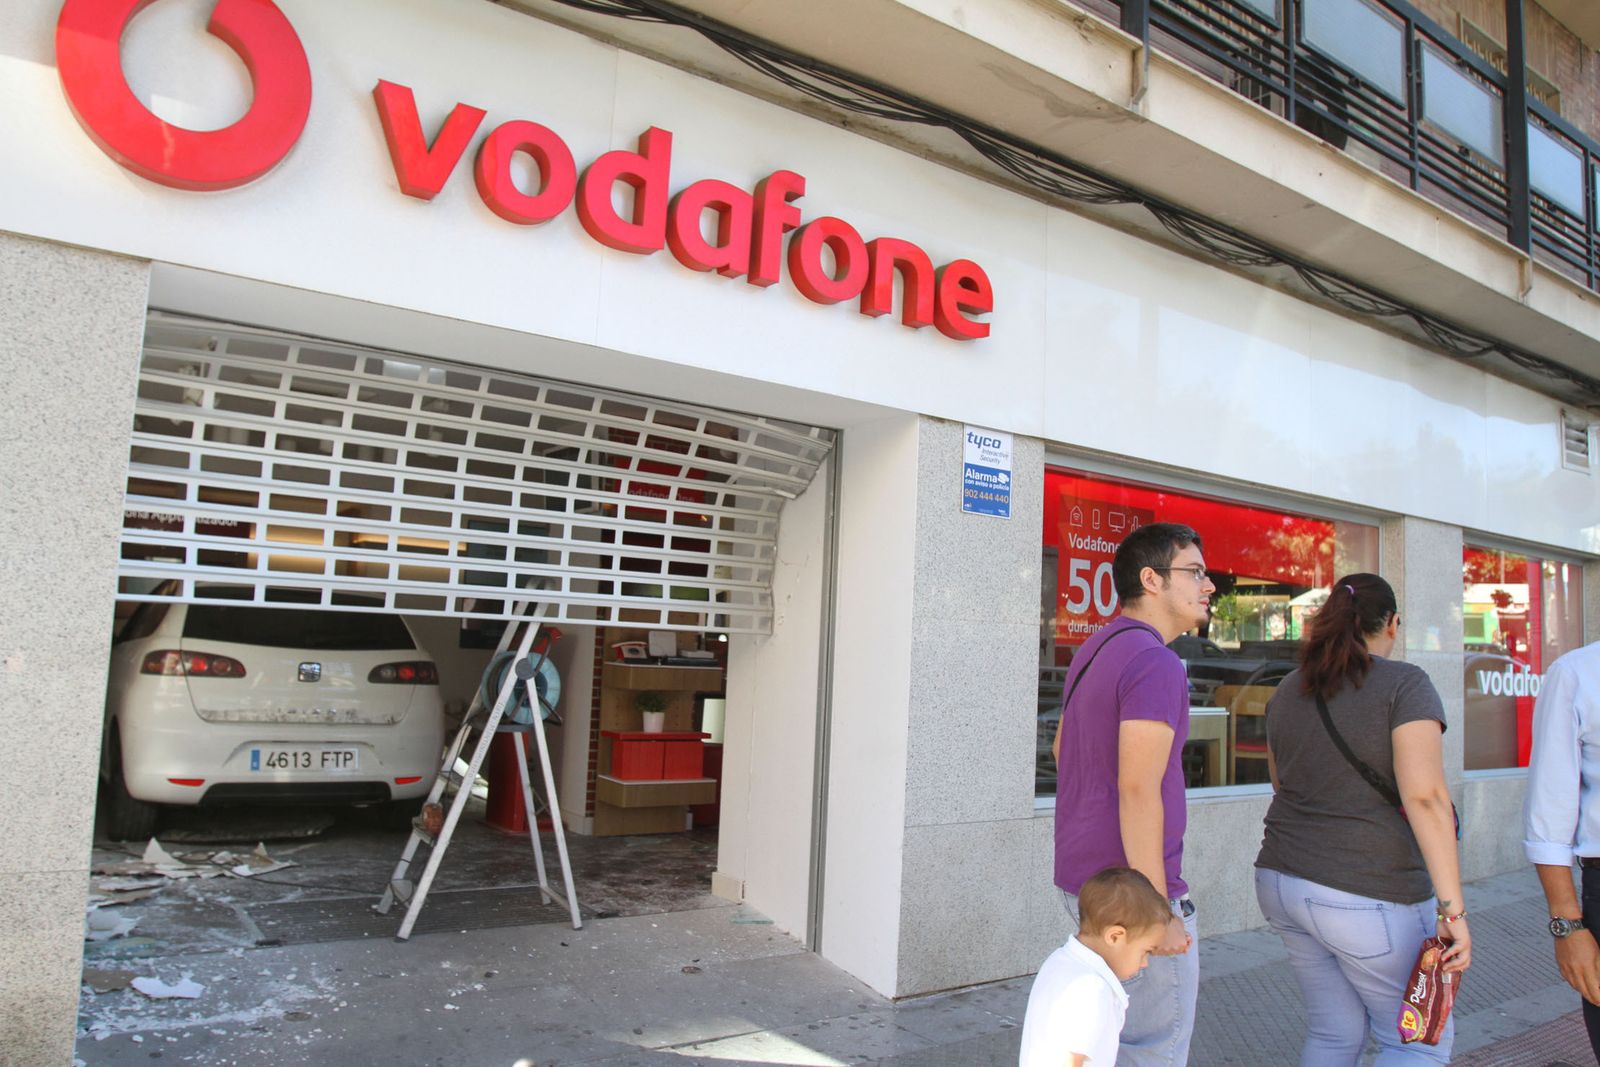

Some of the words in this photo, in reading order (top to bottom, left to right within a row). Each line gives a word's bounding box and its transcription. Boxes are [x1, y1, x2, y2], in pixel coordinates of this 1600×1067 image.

[371, 78, 993, 341] vodafone
[967, 431, 1002, 449] tyco
[980, 454, 1001, 465] Security
[982, 448, 1009, 459] Interactive
[965, 468, 997, 483] Alarma
[975, 480, 988, 488] aviso
[965, 488, 979, 499] 902
[979, 491, 994, 502] 444
[994, 494, 1009, 504] 440
[1066, 557, 1119, 617] 50
[266, 751, 312, 769] 4613
[321, 751, 354, 769] FTP
